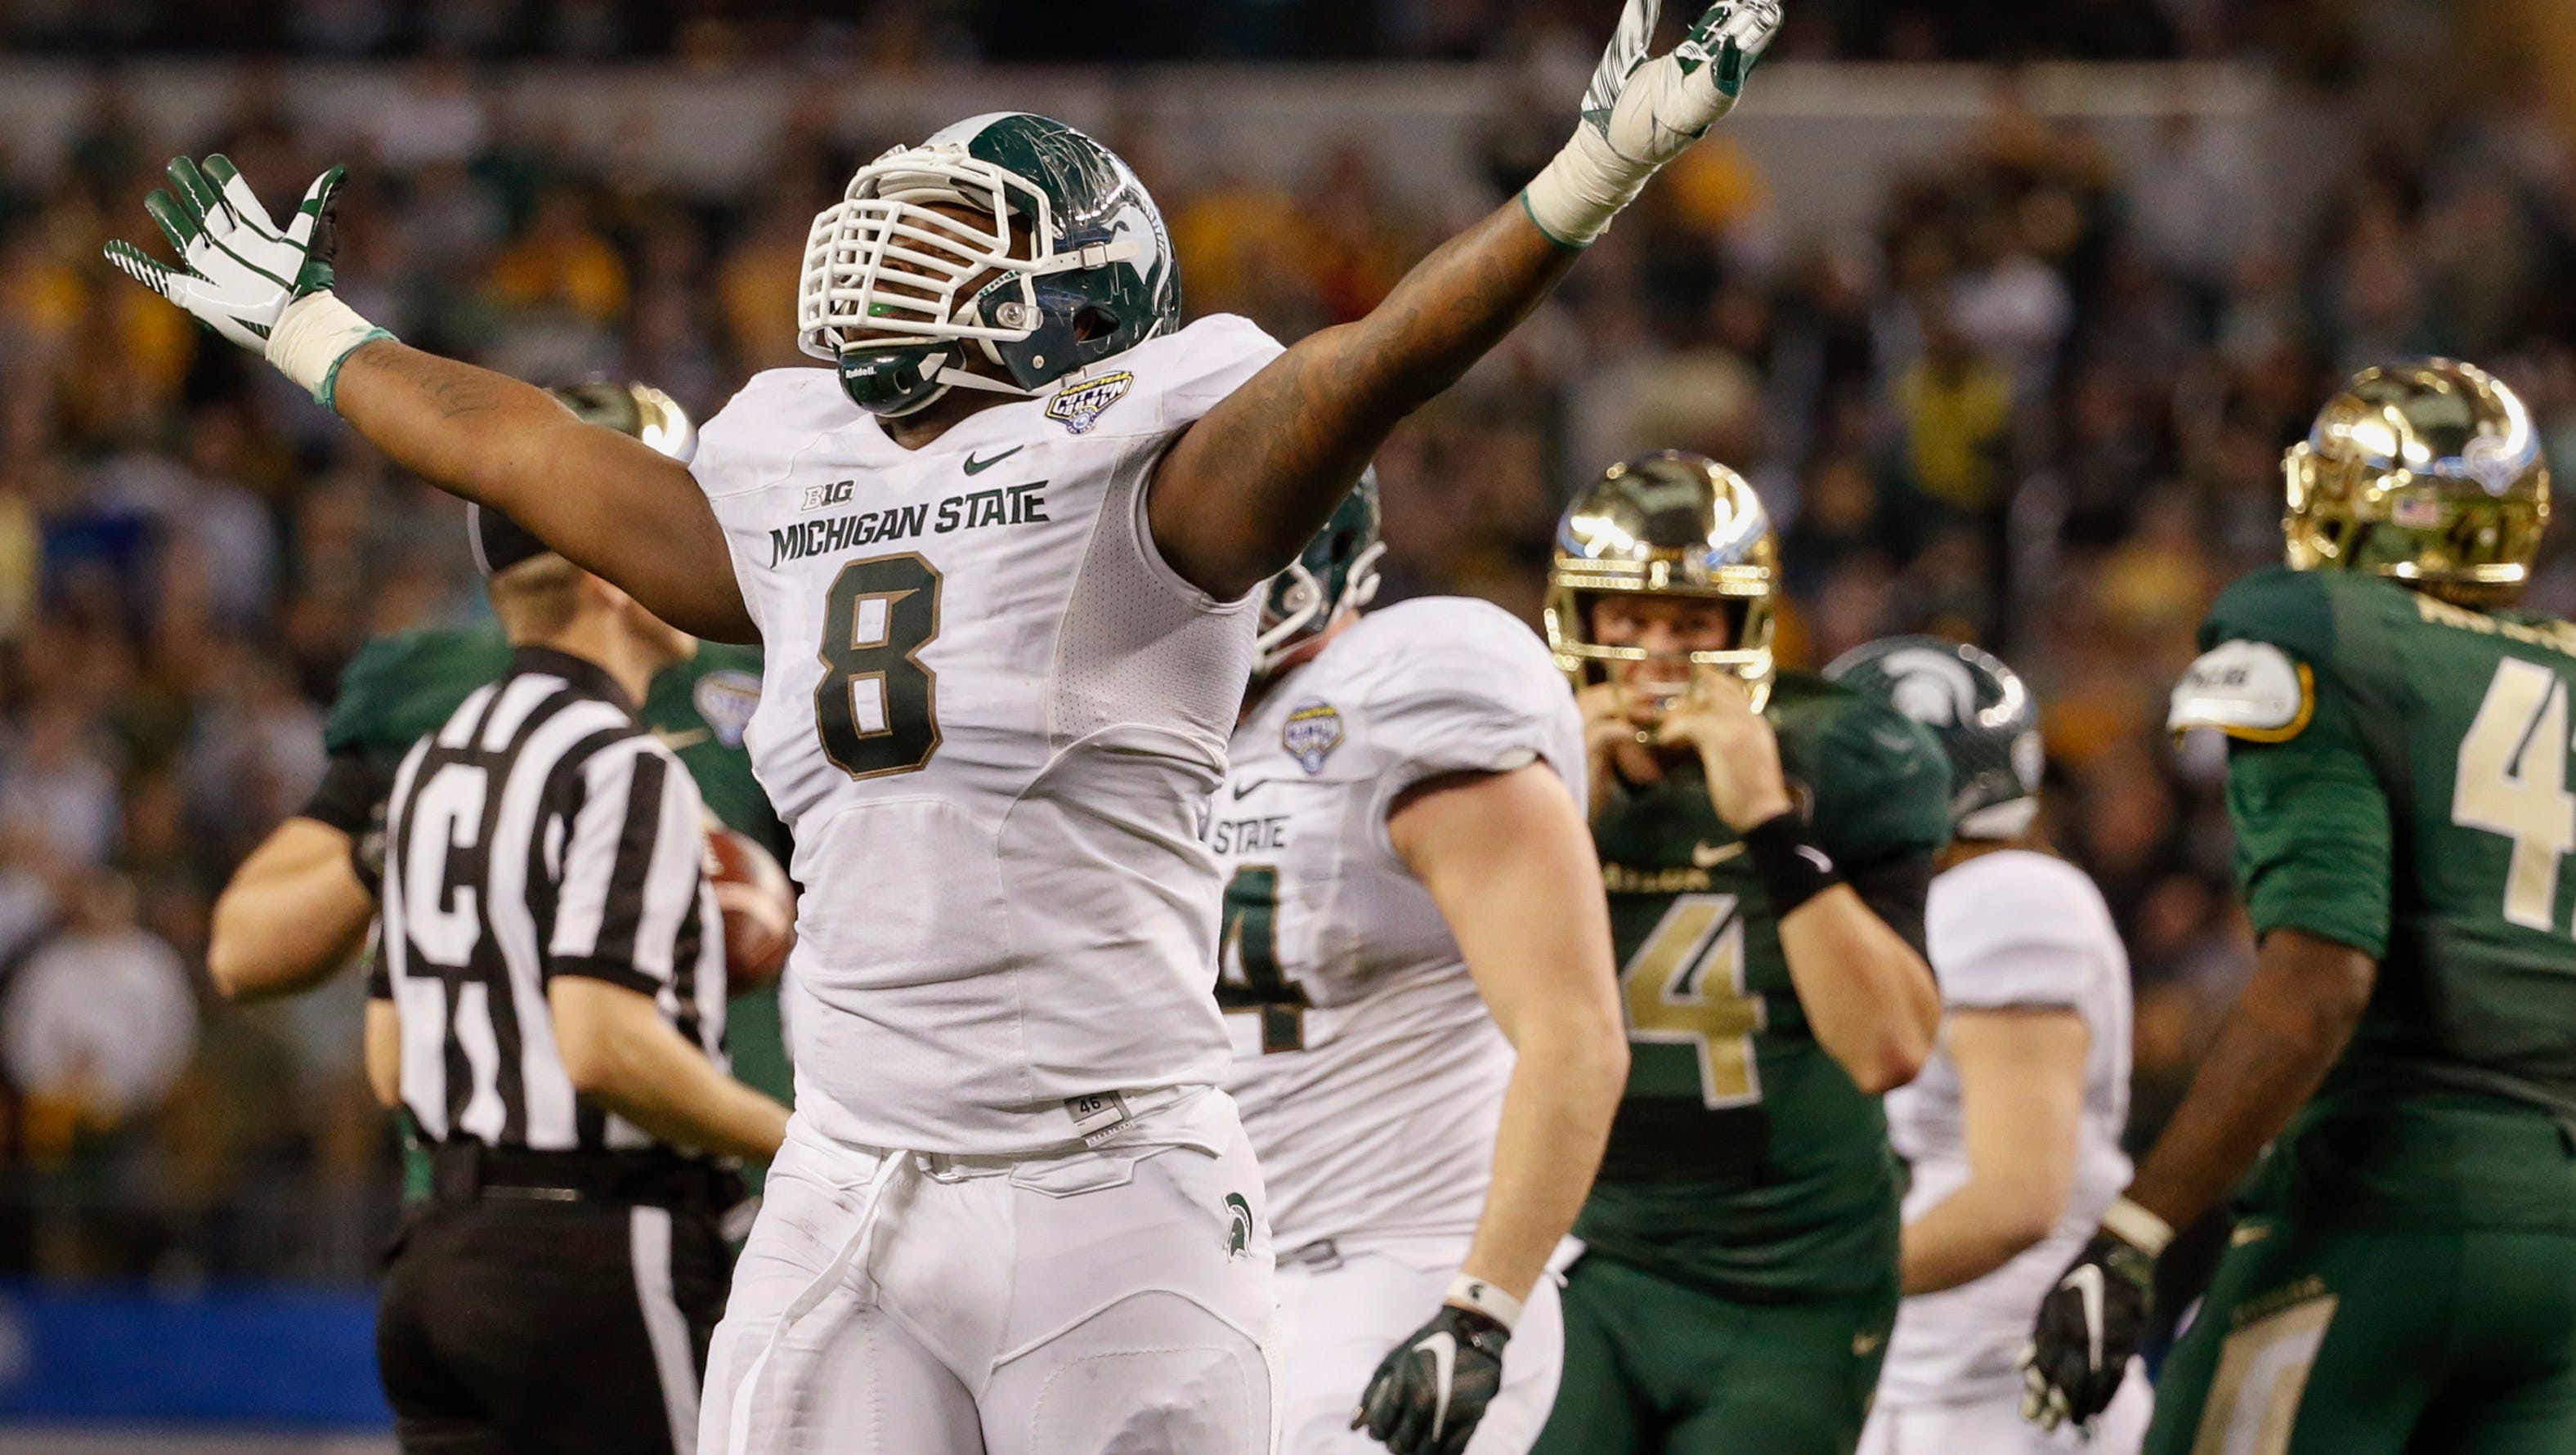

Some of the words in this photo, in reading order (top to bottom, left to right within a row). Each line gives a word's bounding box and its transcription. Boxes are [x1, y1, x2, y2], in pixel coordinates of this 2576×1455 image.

[1052, 378, 1128, 414] COTTON
[769, 504, 930, 570] MICHIGAN
[934, 480, 1051, 534] STATE
[814, 552, 944, 782] 8
[405, 762, 489, 968] C
[1213, 815, 1291, 854] STATE
[1619, 893, 1767, 1110] 4
[1080, 1097, 1101, 1113] 46
